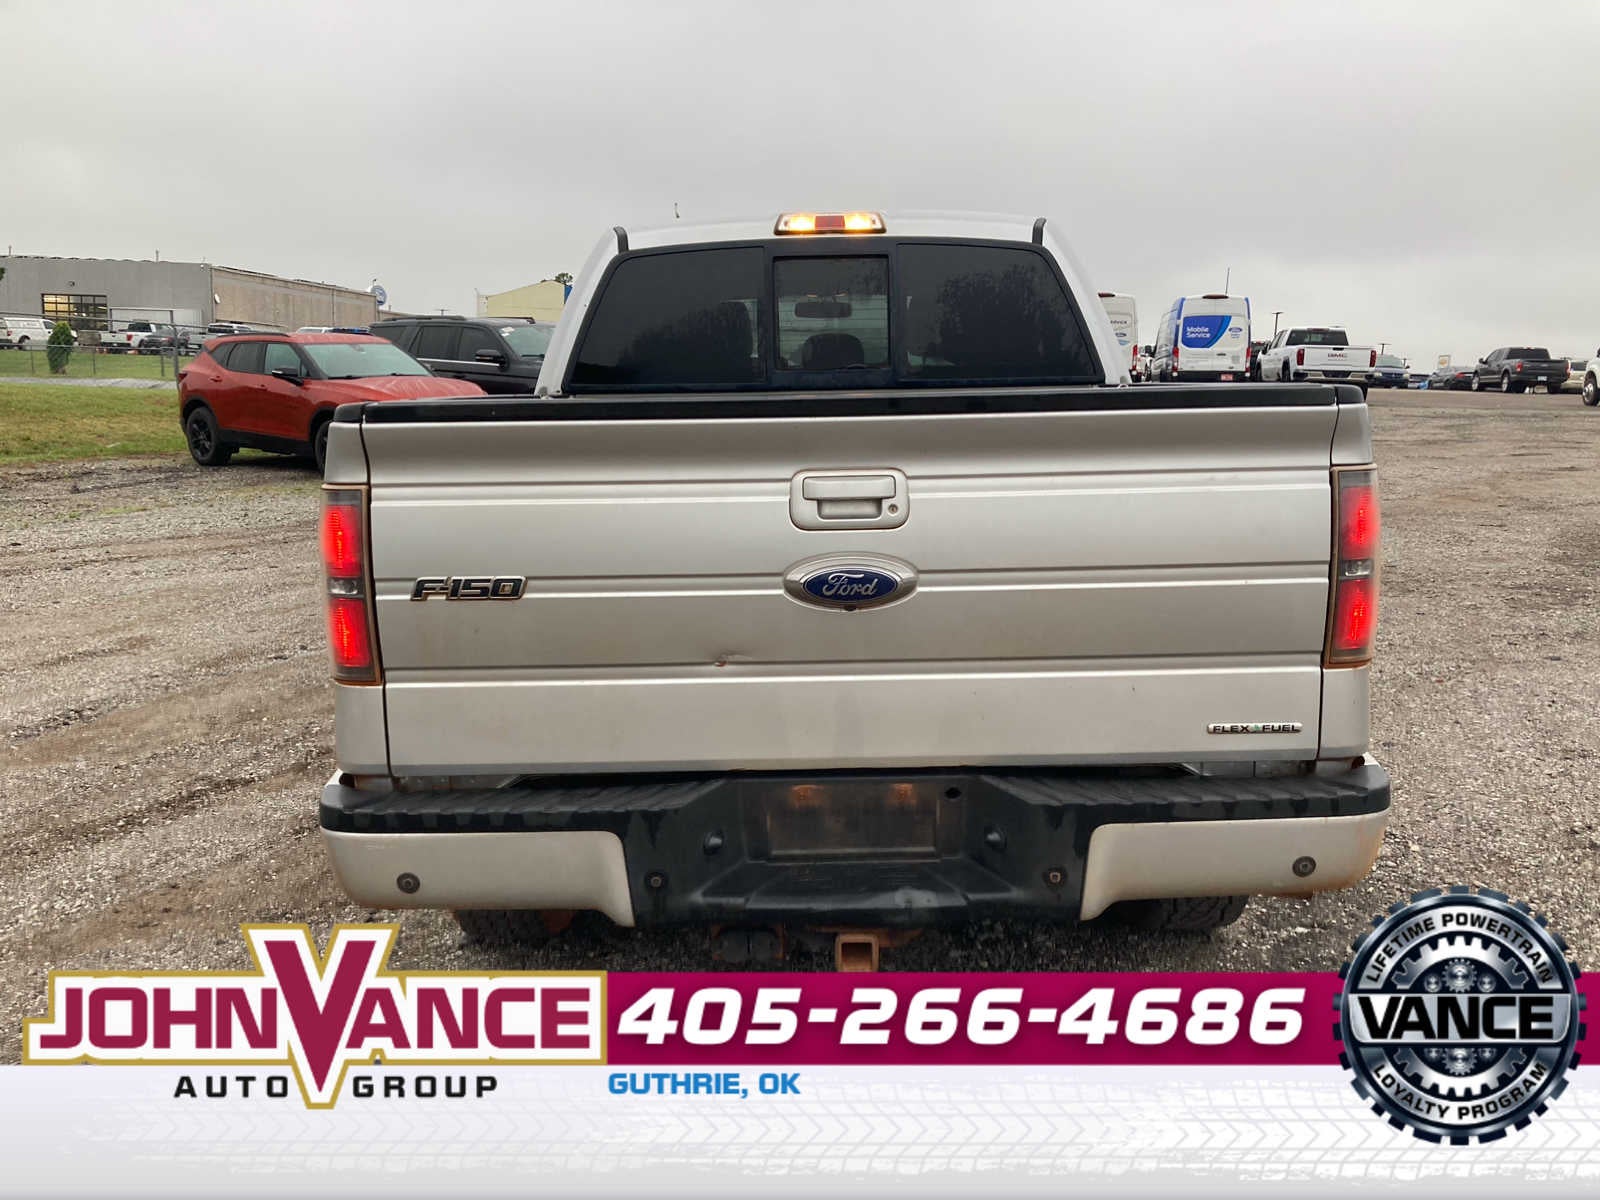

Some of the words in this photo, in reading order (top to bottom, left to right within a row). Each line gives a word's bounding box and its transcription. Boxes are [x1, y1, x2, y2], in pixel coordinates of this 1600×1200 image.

[410, 576, 528, 601] F-150
[822, 572, 879, 596] Ford
[1212, 724, 1250, 734] FLEX
[1261, 724, 1300, 733] FUEL
